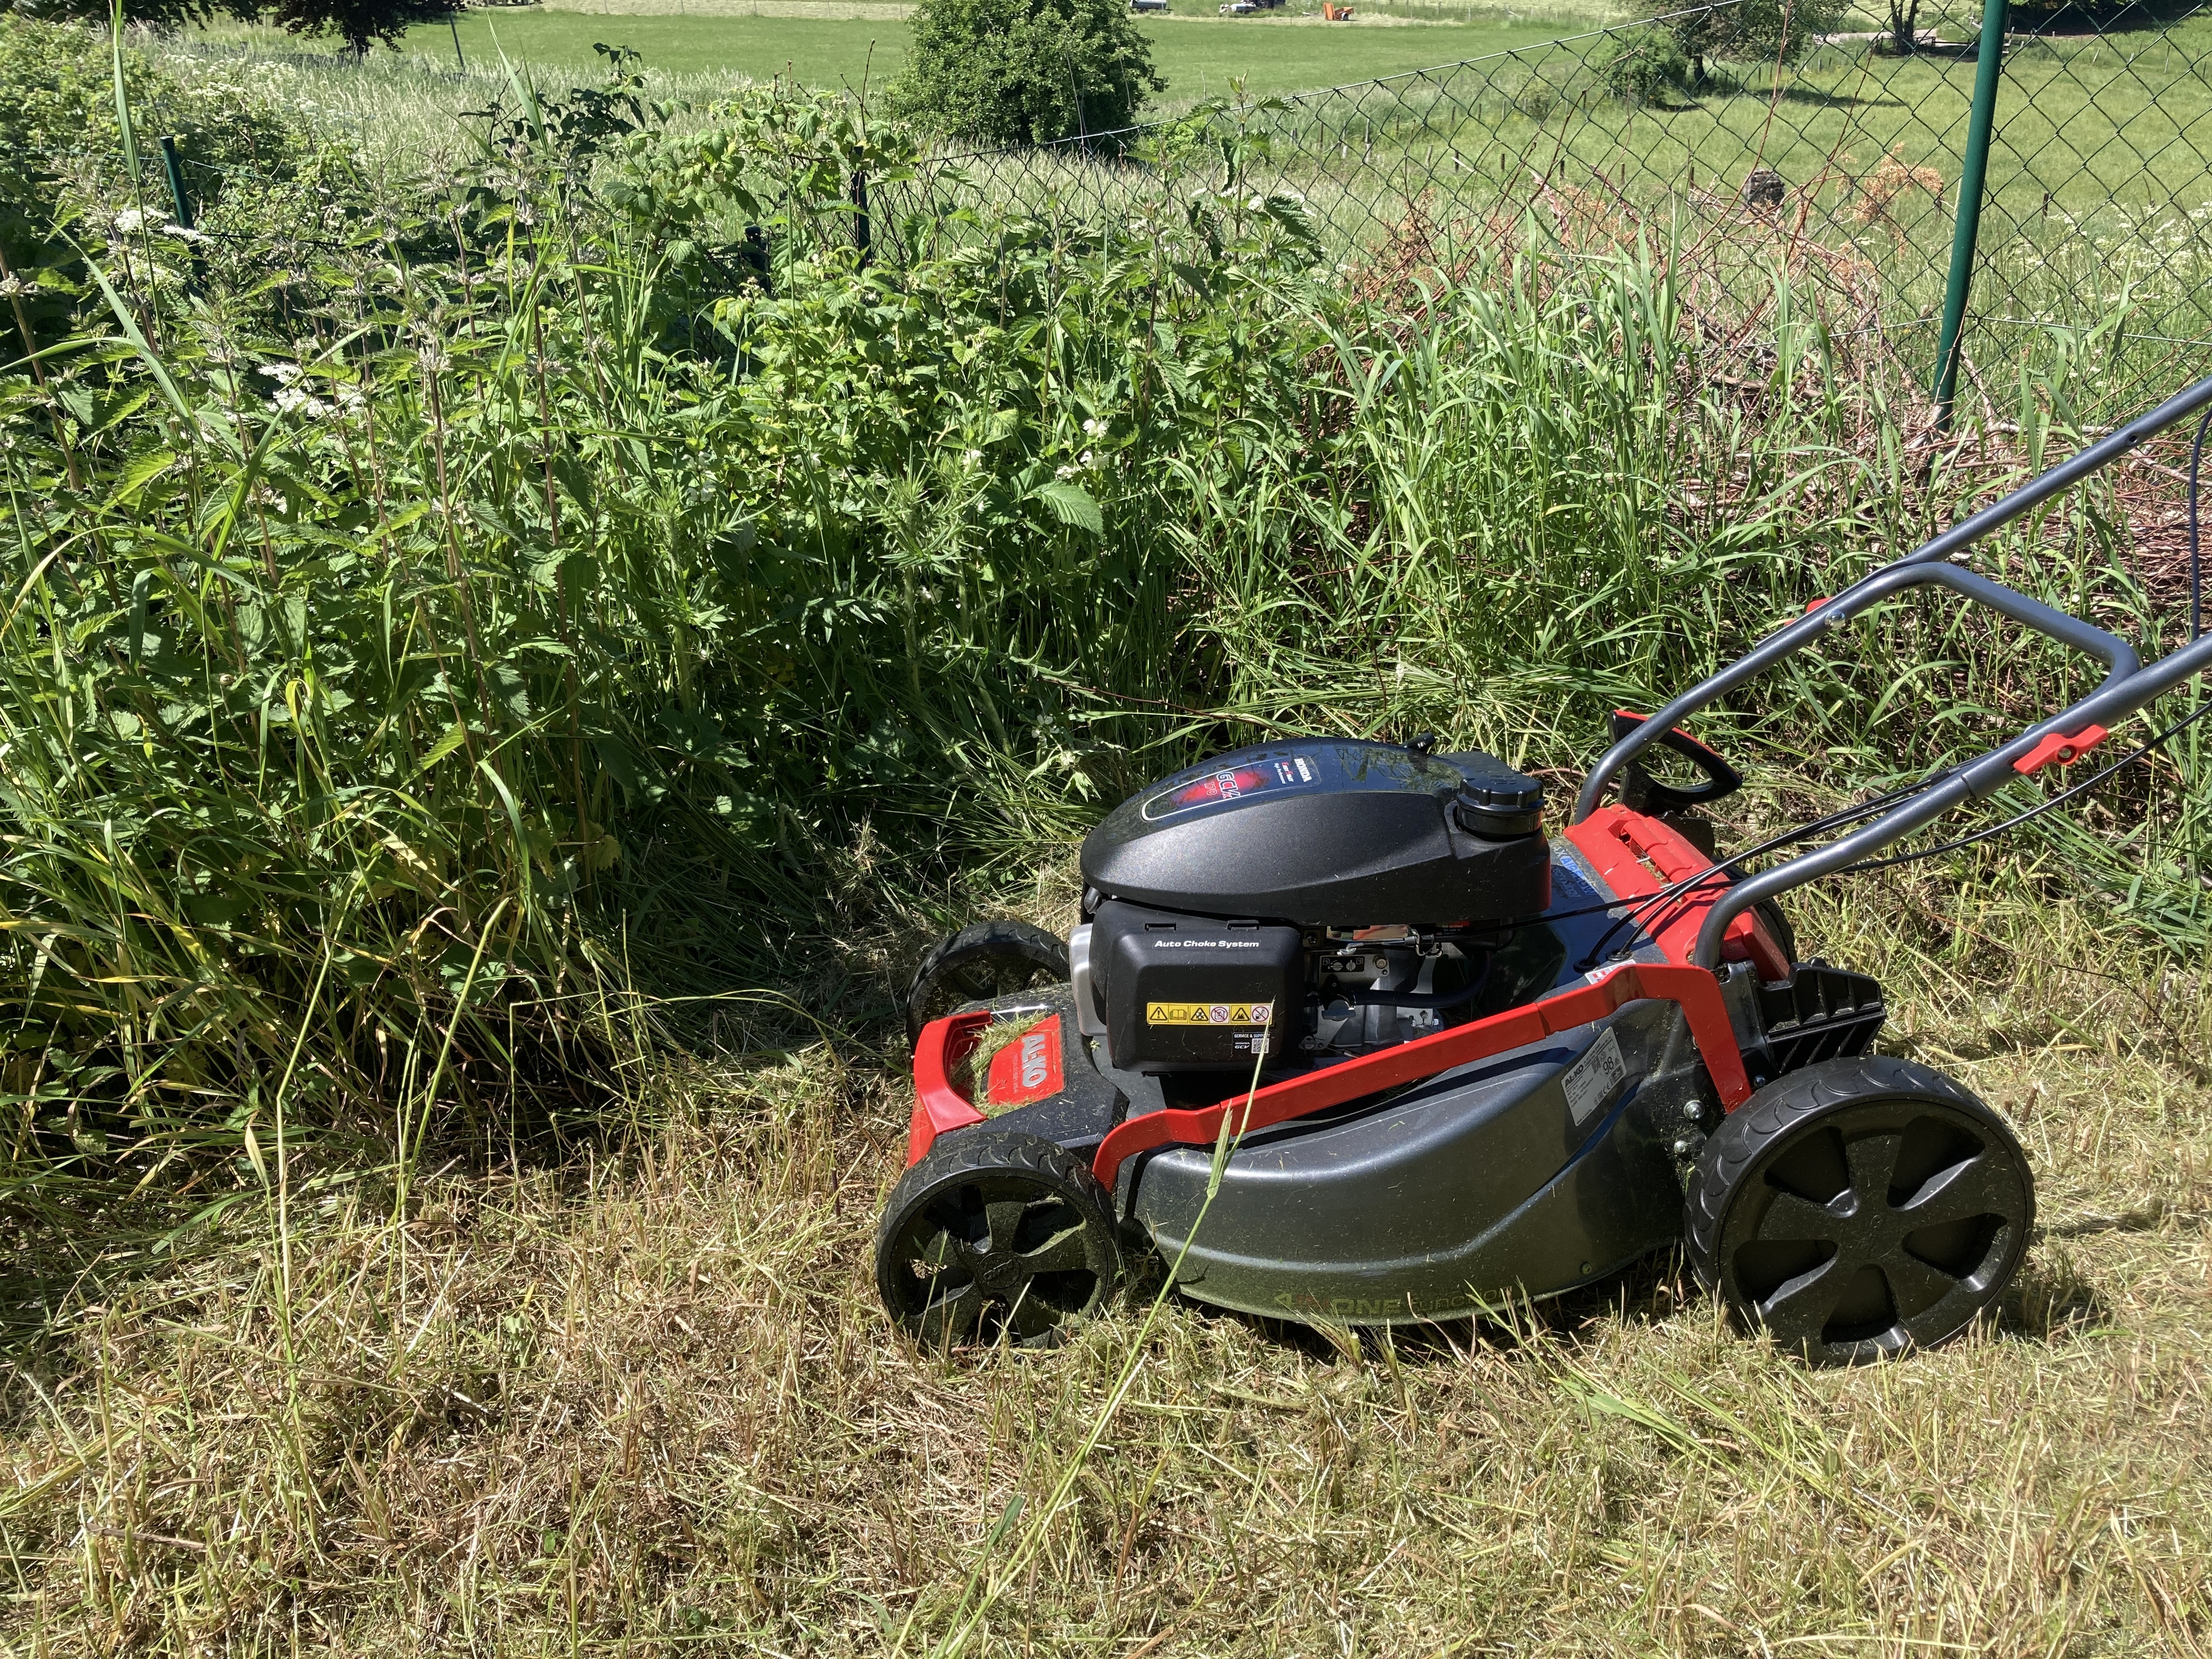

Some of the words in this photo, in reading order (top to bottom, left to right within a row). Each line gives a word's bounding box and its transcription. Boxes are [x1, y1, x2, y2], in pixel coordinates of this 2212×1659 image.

[1294, 758, 1312, 782] HONDA
[1204, 781, 1217, 795] 170
[1560, 857, 1597, 895] AIRFLOW
[1022, 1034, 1047, 1087] AL-KO
[1603, 1057, 1614, 1075] 98
[1565, 1064, 1584, 1088] AL-KO
